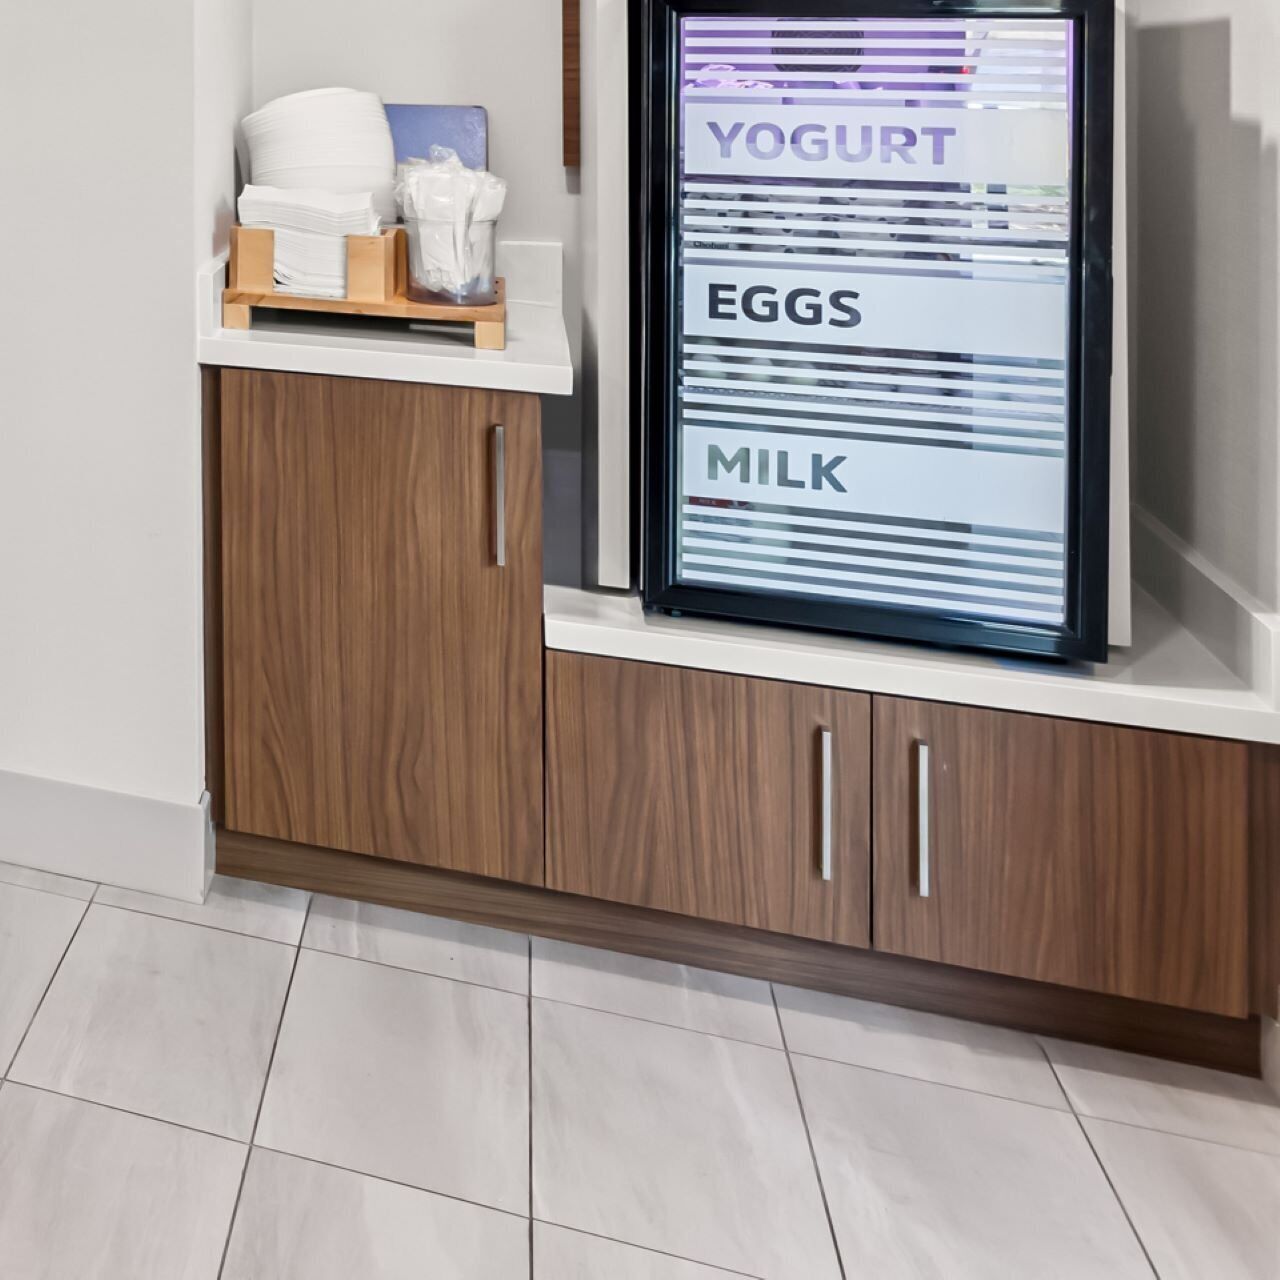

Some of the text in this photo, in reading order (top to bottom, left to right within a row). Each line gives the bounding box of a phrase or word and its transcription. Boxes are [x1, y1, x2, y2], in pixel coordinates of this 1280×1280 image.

[706, 121, 956, 165] YOGURT
[708, 283, 862, 328] EGGS
[707, 444, 848, 493] MILK
